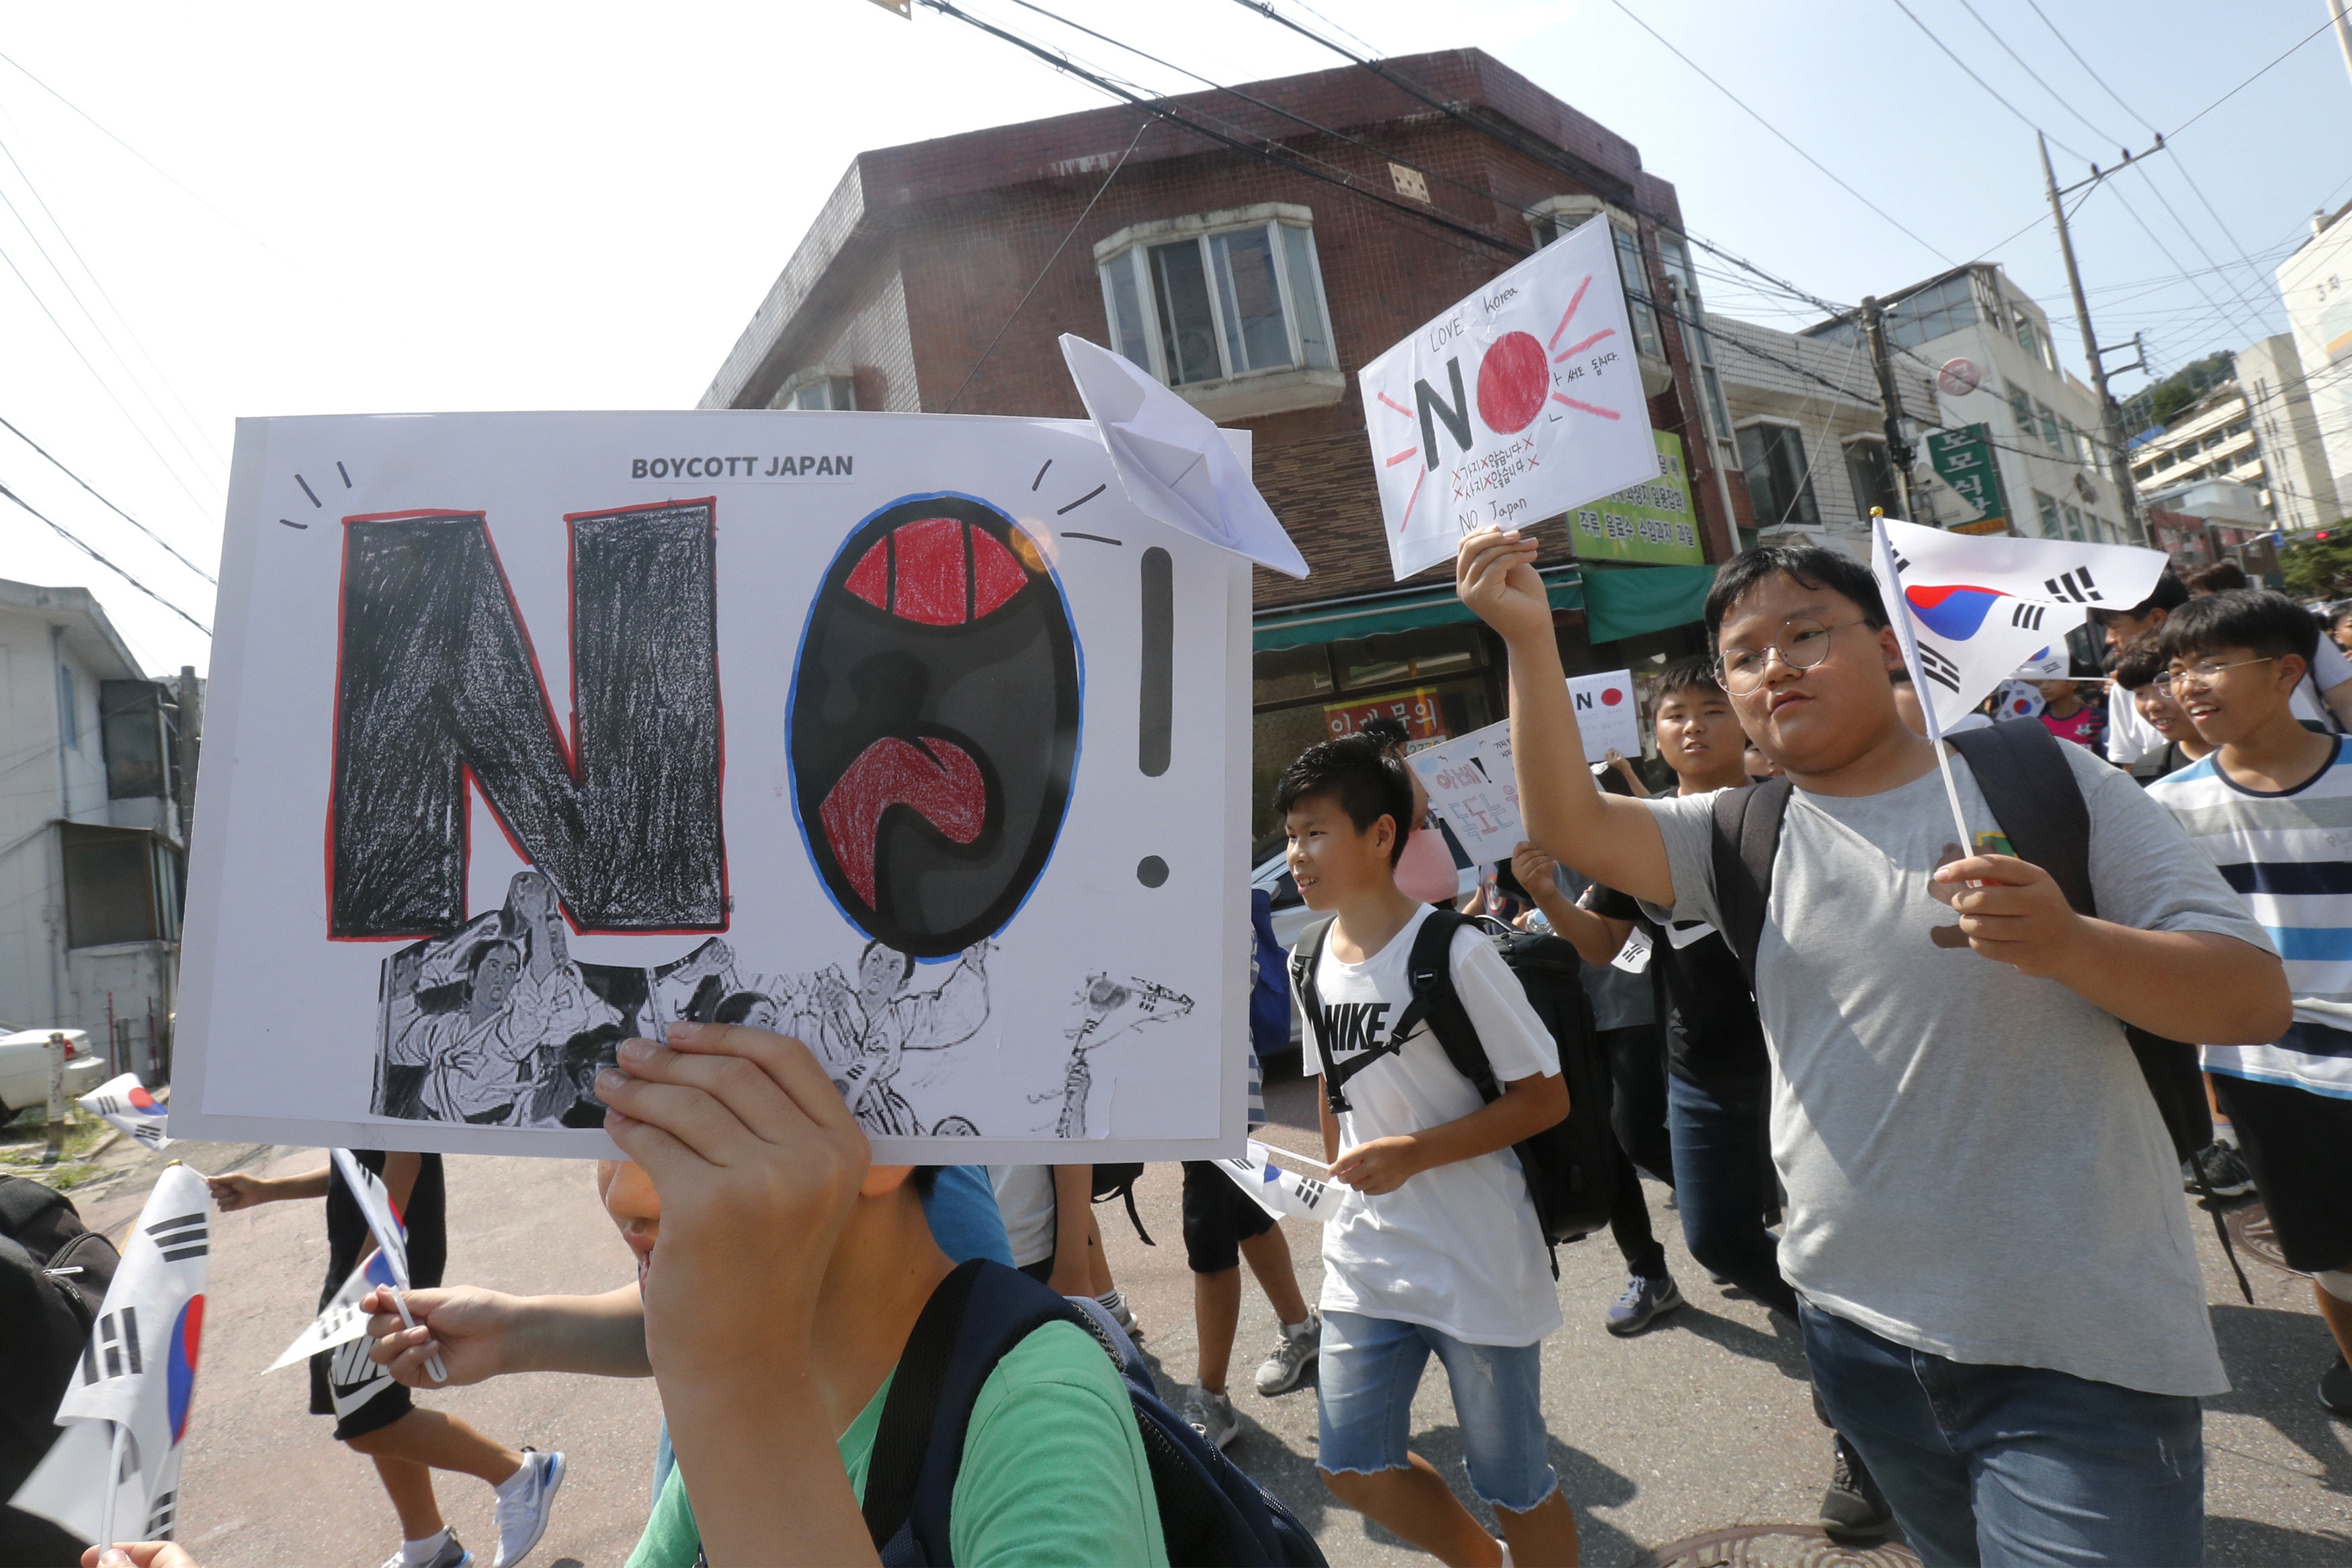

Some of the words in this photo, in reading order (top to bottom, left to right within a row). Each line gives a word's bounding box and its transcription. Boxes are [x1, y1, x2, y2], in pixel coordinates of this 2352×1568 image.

[1430, 318, 1464, 353] LOVE
[632, 456, 759, 479] BOYCOTT
[764, 455, 853, 477] JAPAN
[1459, 509, 1478, 537] NO
[1488, 497, 1527, 521] Japan
[1579, 511, 1601, 537] 주류
[1605, 513, 1634, 541] 음료수
[1638, 517, 1675, 546] 수입과자
[1324, 1002, 1391, 1051] NIKE
